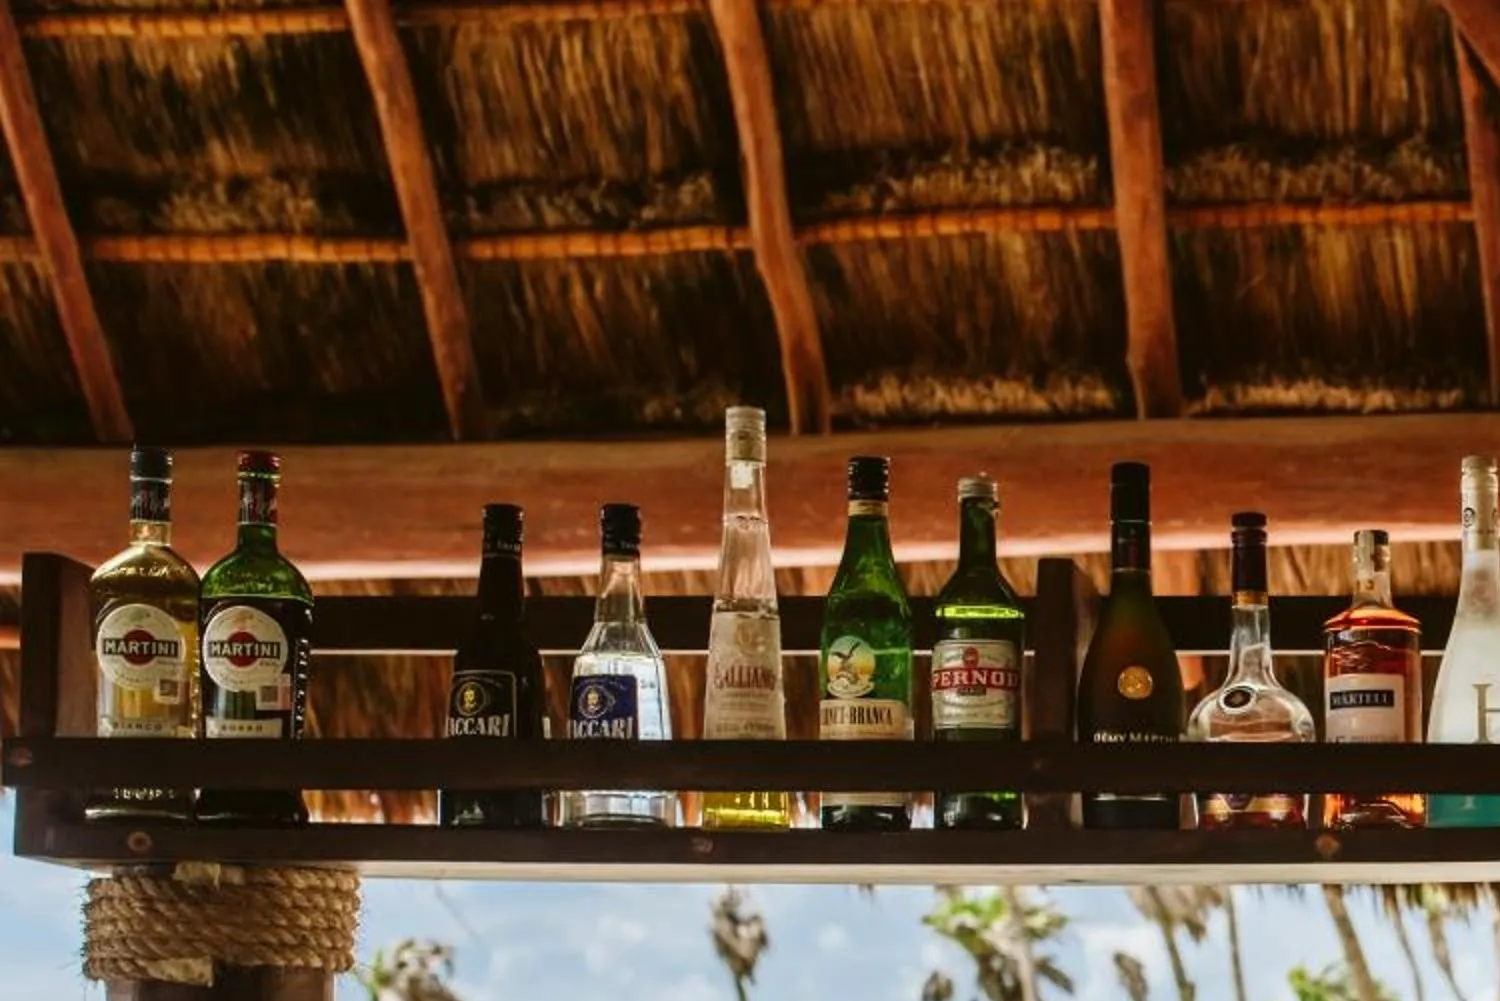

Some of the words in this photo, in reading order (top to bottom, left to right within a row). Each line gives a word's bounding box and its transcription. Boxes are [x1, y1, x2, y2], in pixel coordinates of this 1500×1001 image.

[104, 639, 176, 655] MARTINI
[210, 641, 279, 658] MARTINI
[448, 713, 512, 737] CCARI
[570, 717, 634, 739] CCARI
